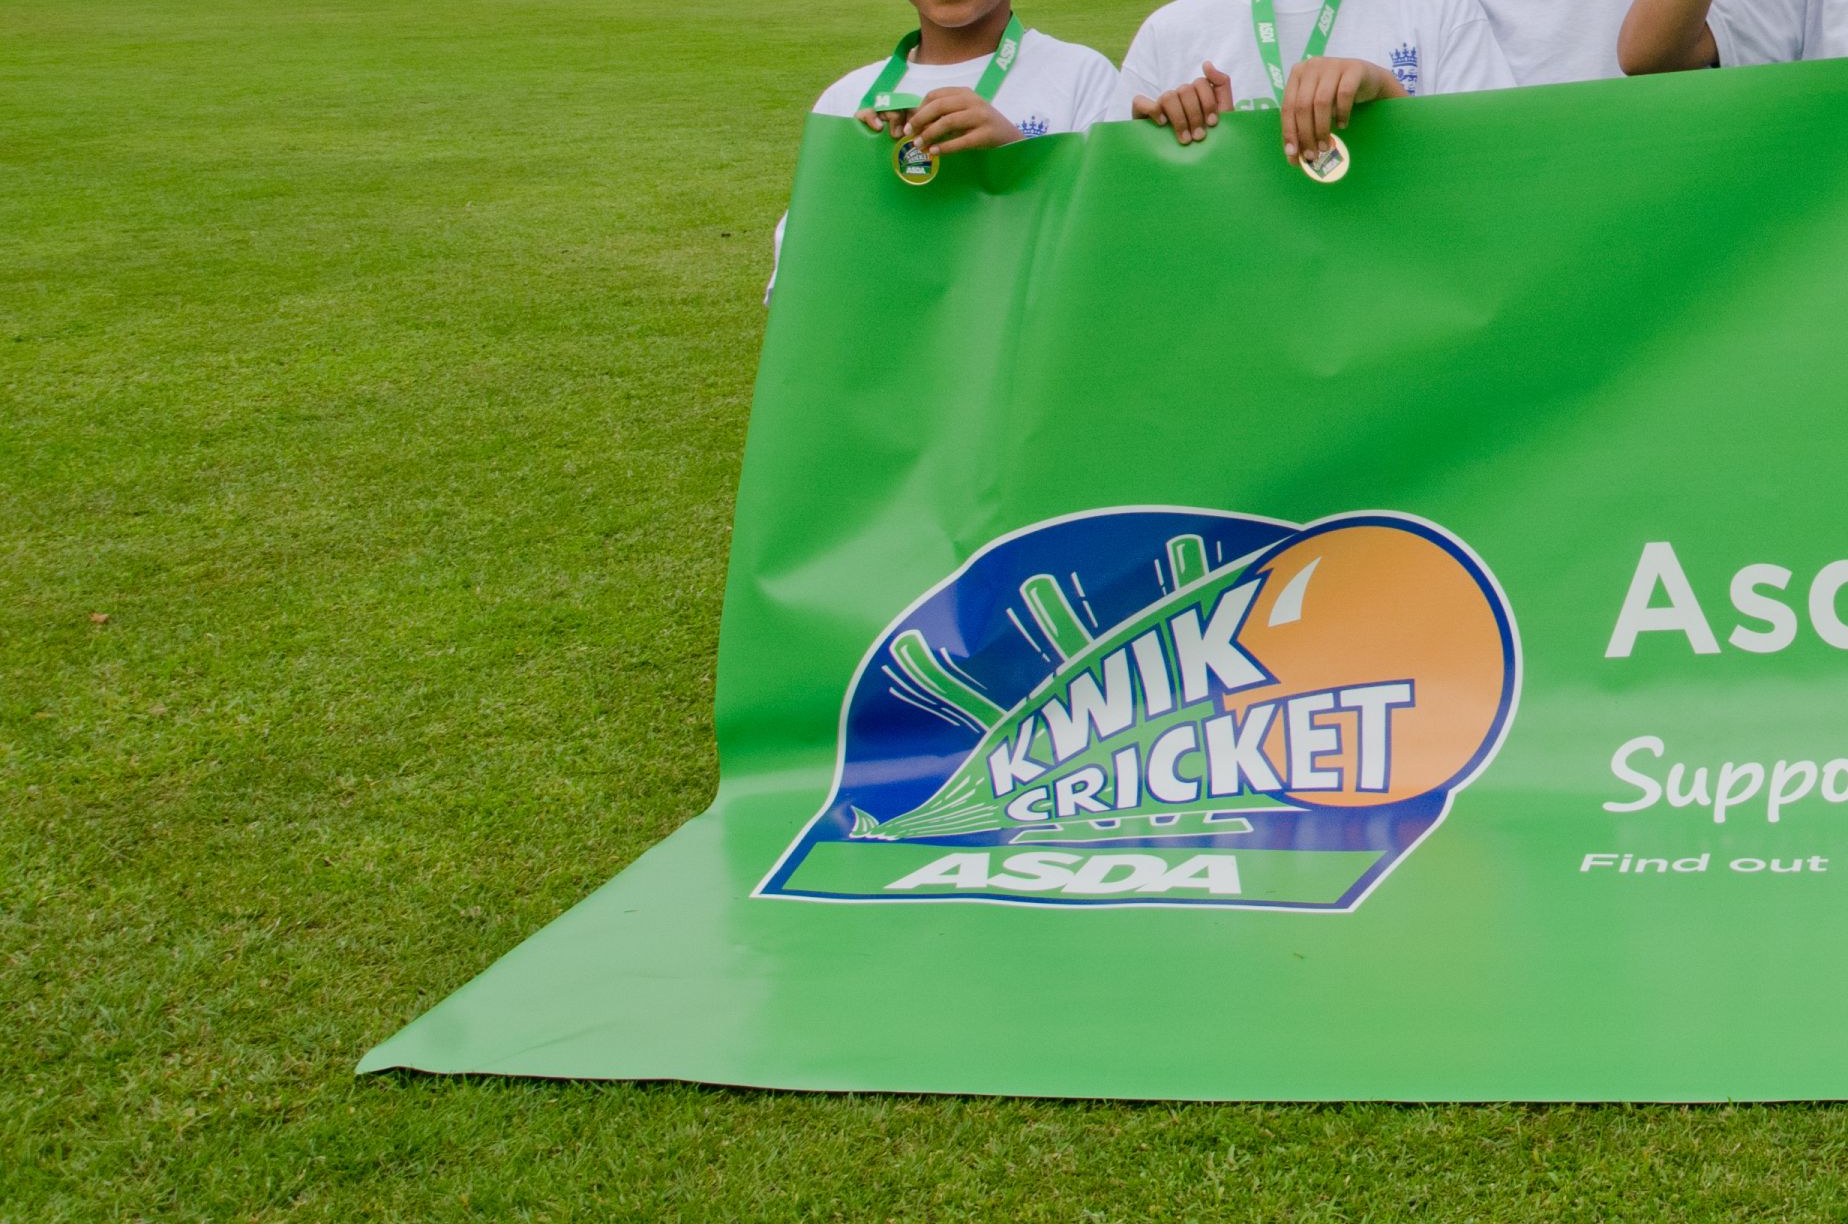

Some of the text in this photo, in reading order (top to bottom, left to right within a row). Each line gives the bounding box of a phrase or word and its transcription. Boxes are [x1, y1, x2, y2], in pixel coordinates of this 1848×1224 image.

[1318, 4, 1335, 37] ASDA
[990, 578, 1273, 796] KWIK
[1007, 684, 1412, 822] CRICKET
[884, 852, 1242, 895] ASDA
[1579, 853, 1710, 874] Find
[1729, 855, 1829, 873] out
